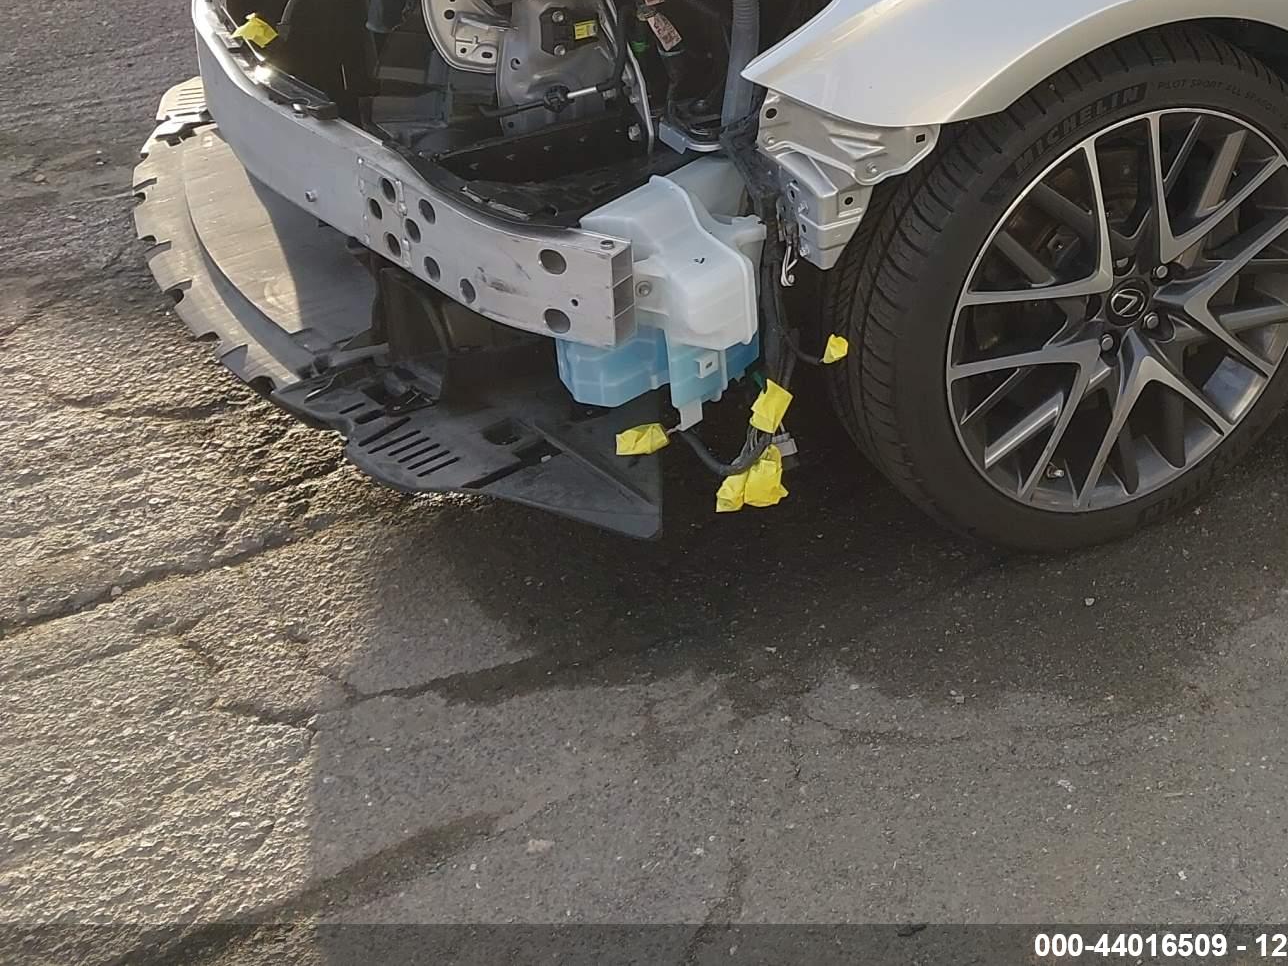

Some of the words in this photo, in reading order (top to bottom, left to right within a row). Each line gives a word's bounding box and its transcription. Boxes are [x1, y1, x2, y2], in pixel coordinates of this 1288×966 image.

[1157, 79, 1187, 90] PILOT
[1190, 78, 1224, 90] SPORT
[1014, 86, 1141, 178] MICHELIN
